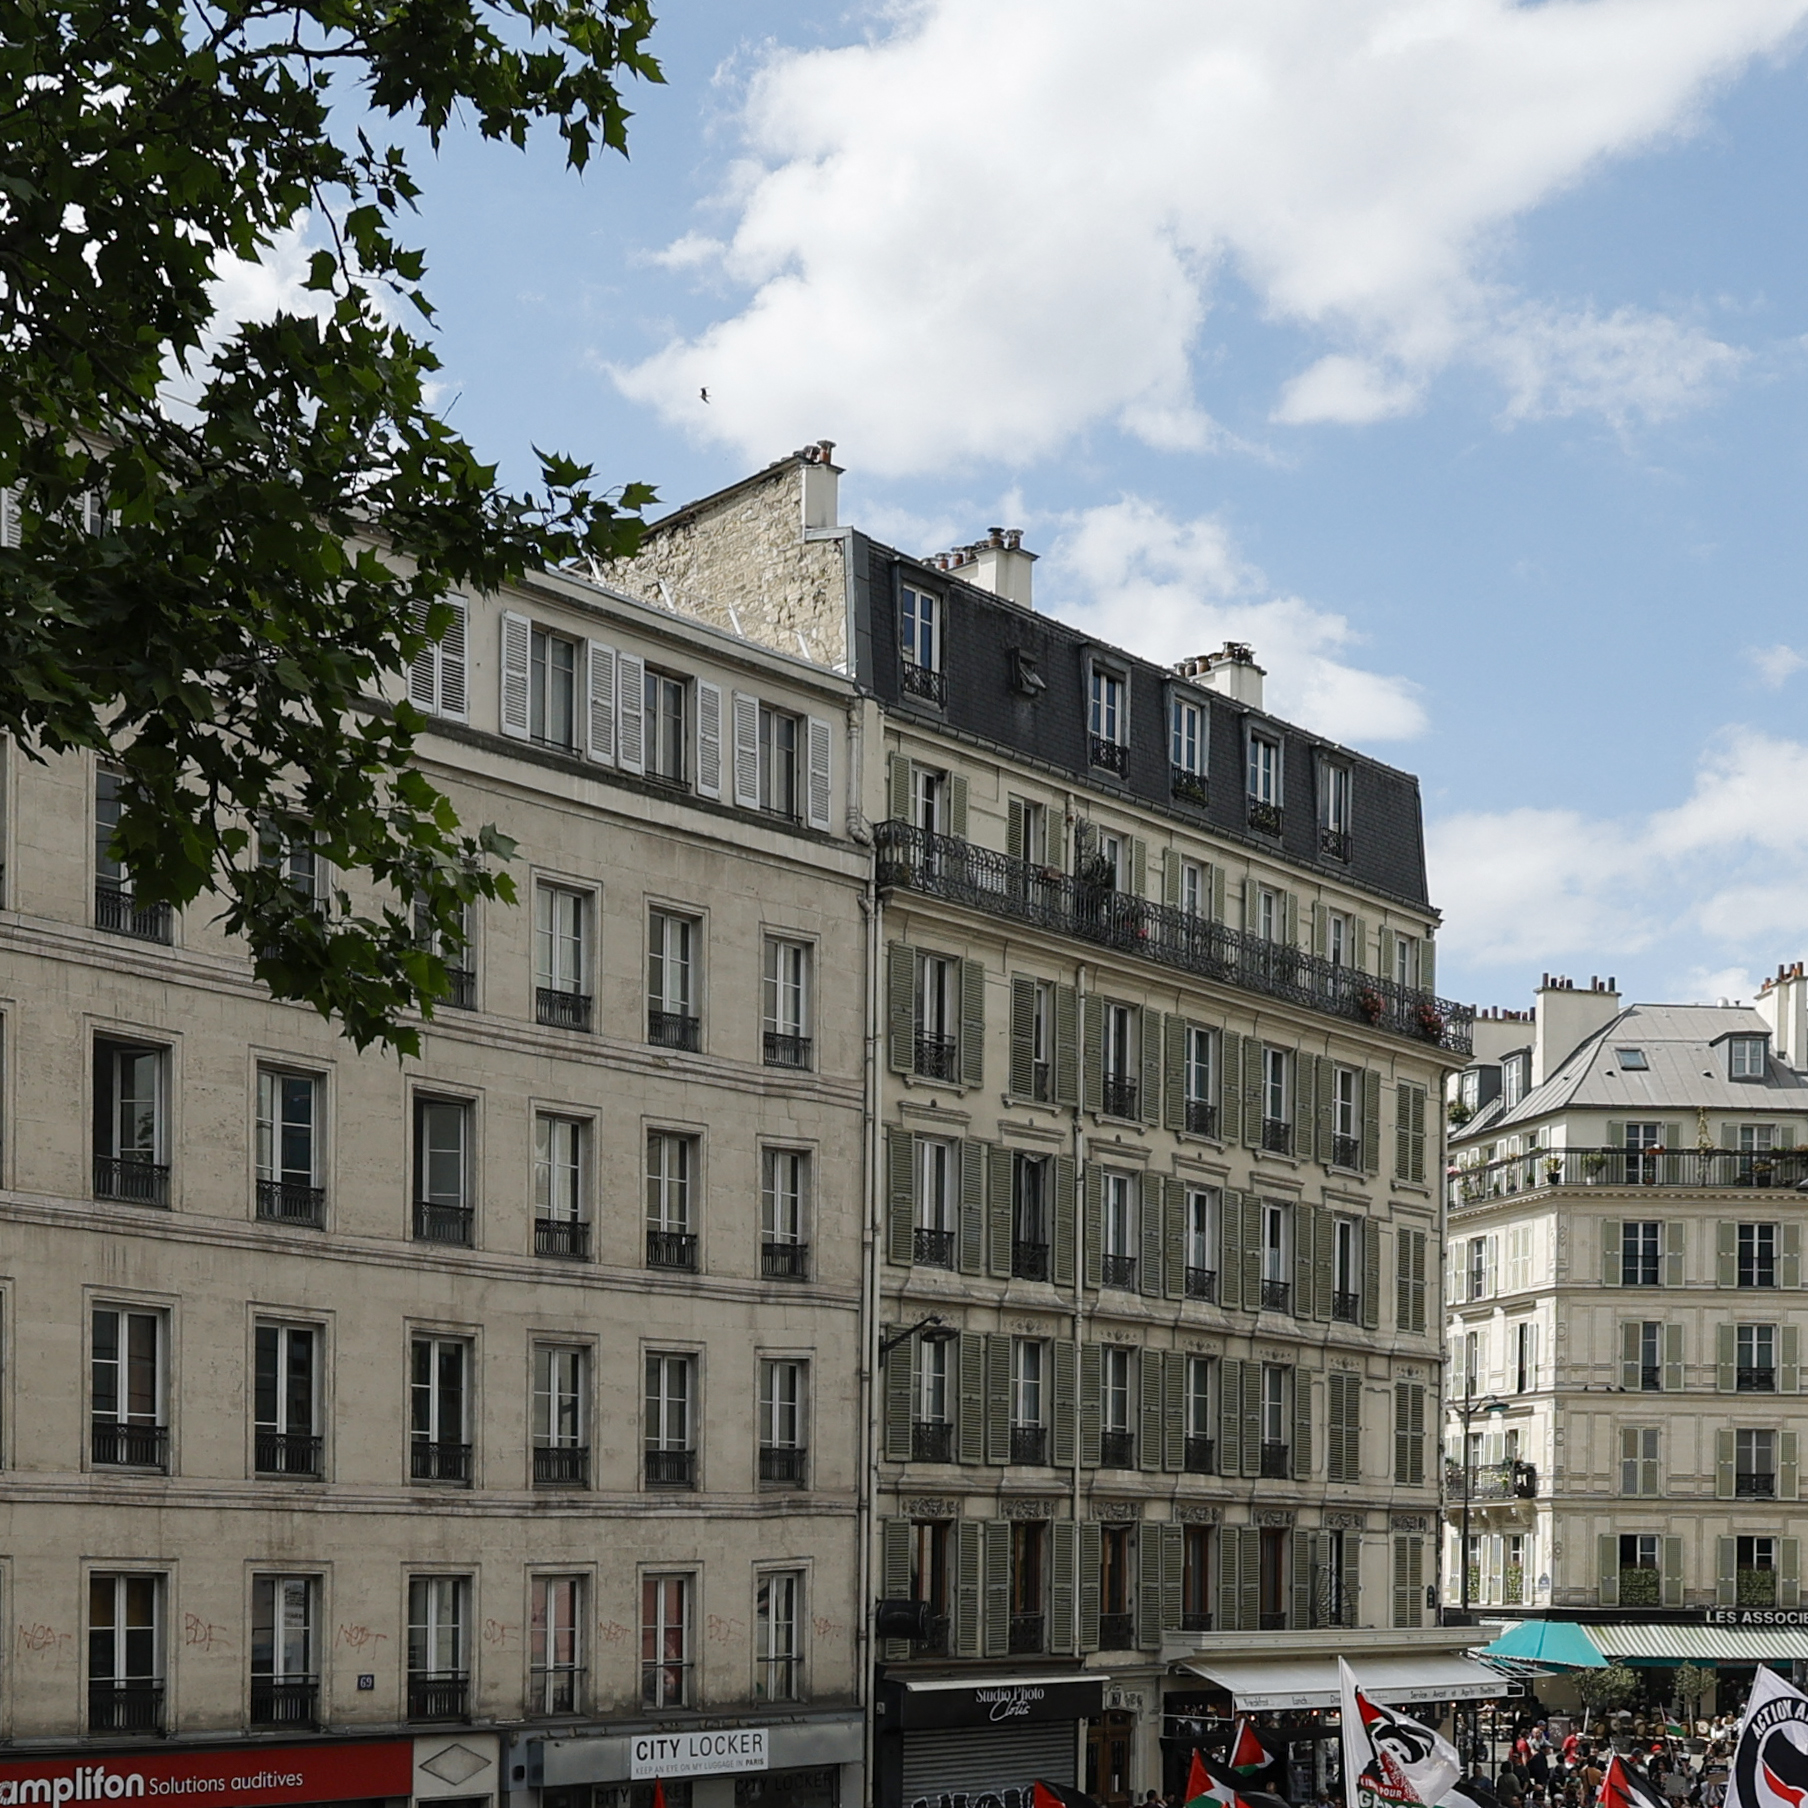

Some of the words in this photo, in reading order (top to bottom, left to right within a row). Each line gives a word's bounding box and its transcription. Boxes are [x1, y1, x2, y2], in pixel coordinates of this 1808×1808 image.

[1706, 1610, 1737, 1624] LES
[360, 1677, 372, 1688] 69
[975, 1687, 1012, 1703] Studio
[1013, 1686, 1045, 1701] Photo
[1751, 1699, 1793, 1741] ACTION
[636, 1739, 681, 1761] CITY
[690, 1734, 763, 1758] LOCKER
[746, 1758, 764, 1767] PARIS
[148, 1776, 225, 1797] Solutions
[231, 1771, 303, 1791] auditives
